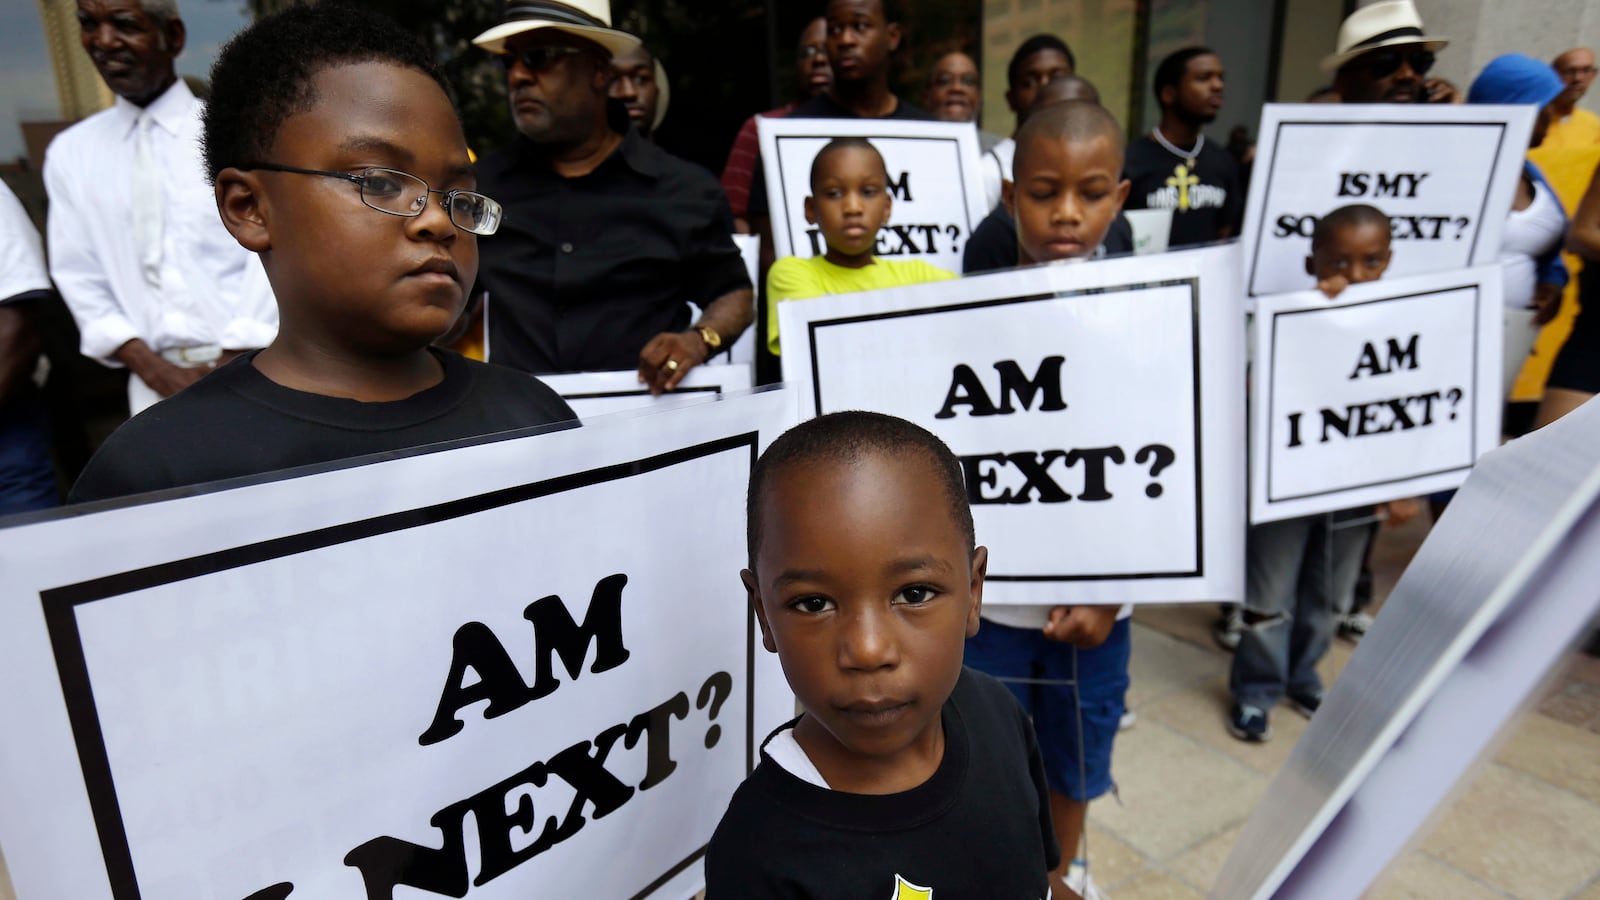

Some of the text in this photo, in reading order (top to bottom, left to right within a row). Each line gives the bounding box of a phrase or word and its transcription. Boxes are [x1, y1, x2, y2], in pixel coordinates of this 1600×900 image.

[1336, 172, 1428, 198] IS MY
[872, 223, 960, 256] EXT?
[1273, 214, 1470, 240] SO EXT?
[1348, 333, 1420, 380] AM
[934, 355, 1068, 420] AM
[1286, 387, 1463, 448] I NEXT?
[958, 443, 1176, 505] EXT?
[418, 573, 630, 746] AM
